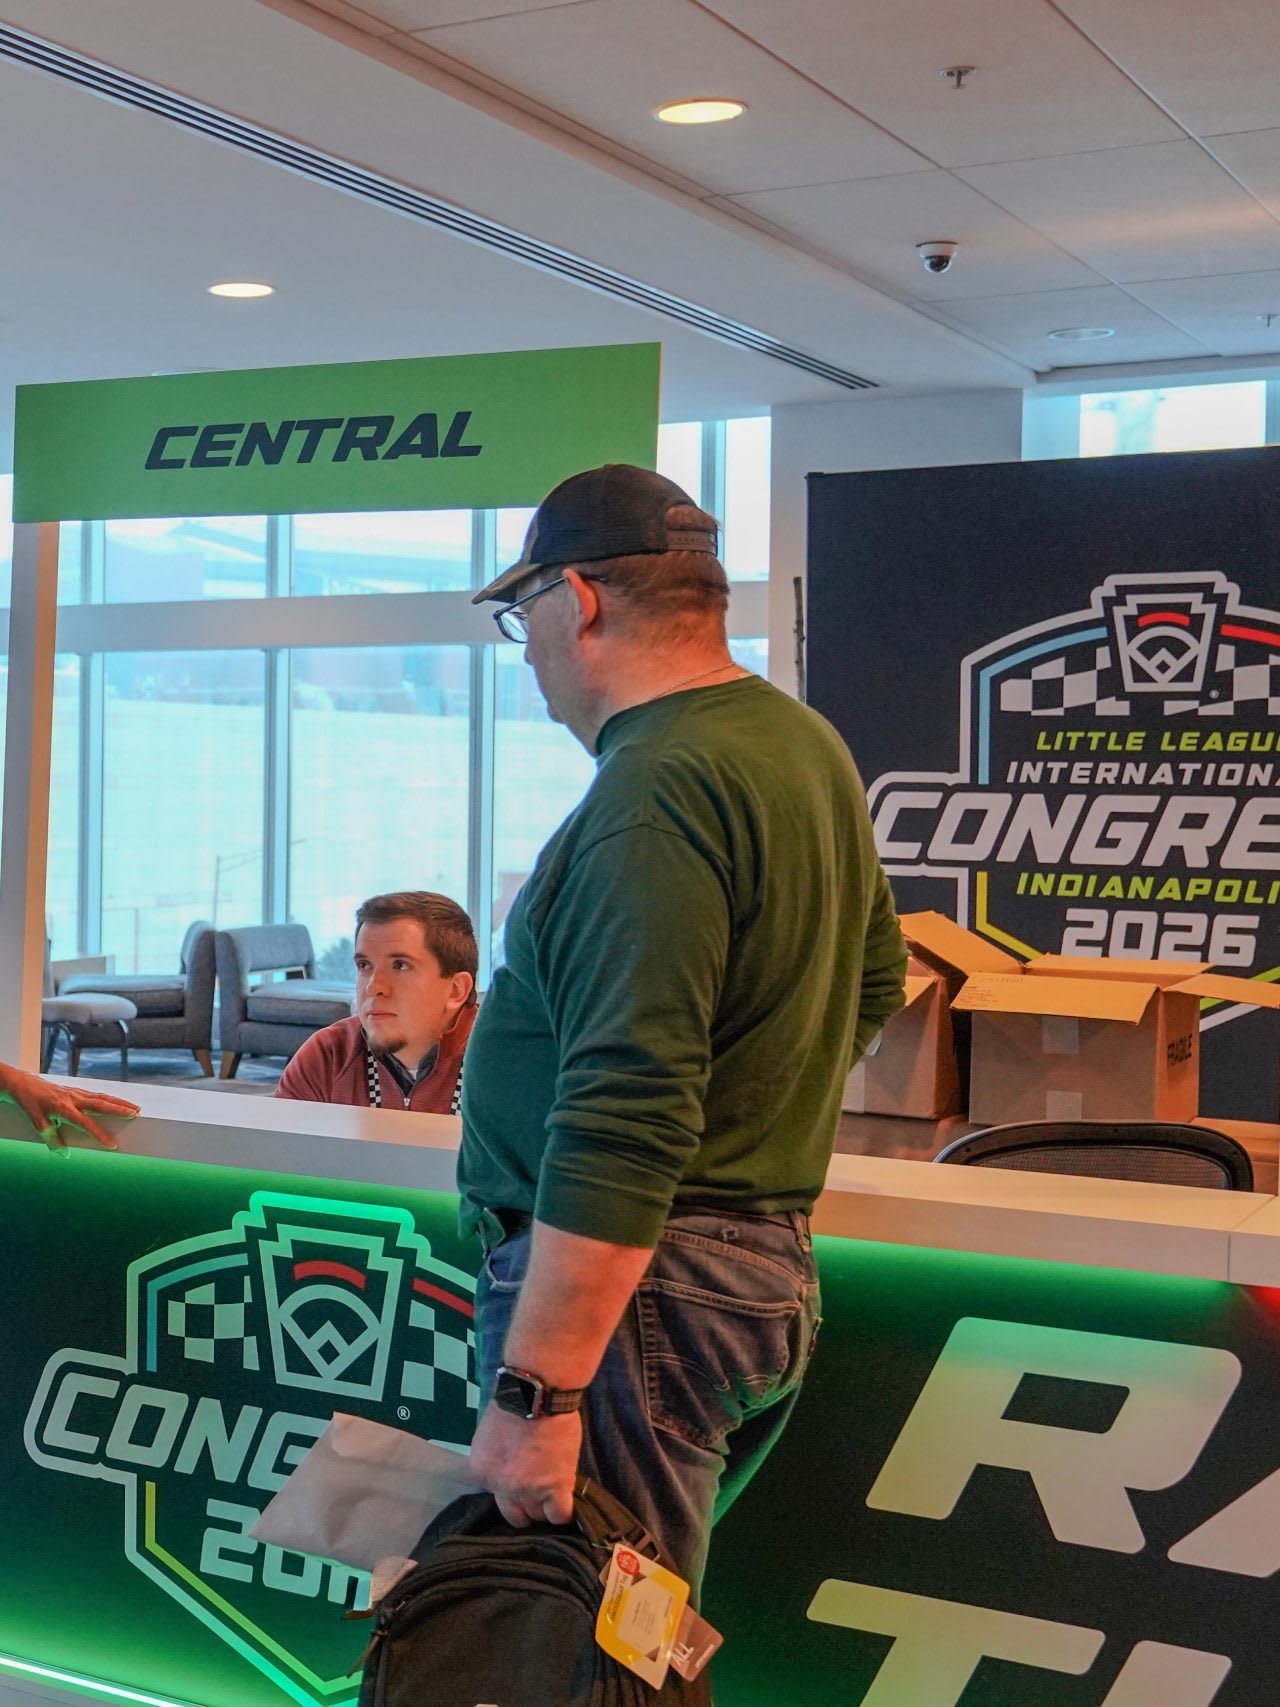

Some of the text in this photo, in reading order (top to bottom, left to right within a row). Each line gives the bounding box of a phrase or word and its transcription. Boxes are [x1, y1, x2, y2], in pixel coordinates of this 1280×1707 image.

[145, 411, 483, 470] CENTRAL
[1036, 731, 1280, 752] LITTLE LEAGU
[873, 791, 1280, 871] CONGRE
[1016, 873, 1280, 905] INDIANAPOLI
[1060, 908, 1260, 968] 2026
[42, 1372, 471, 1494] CONG
